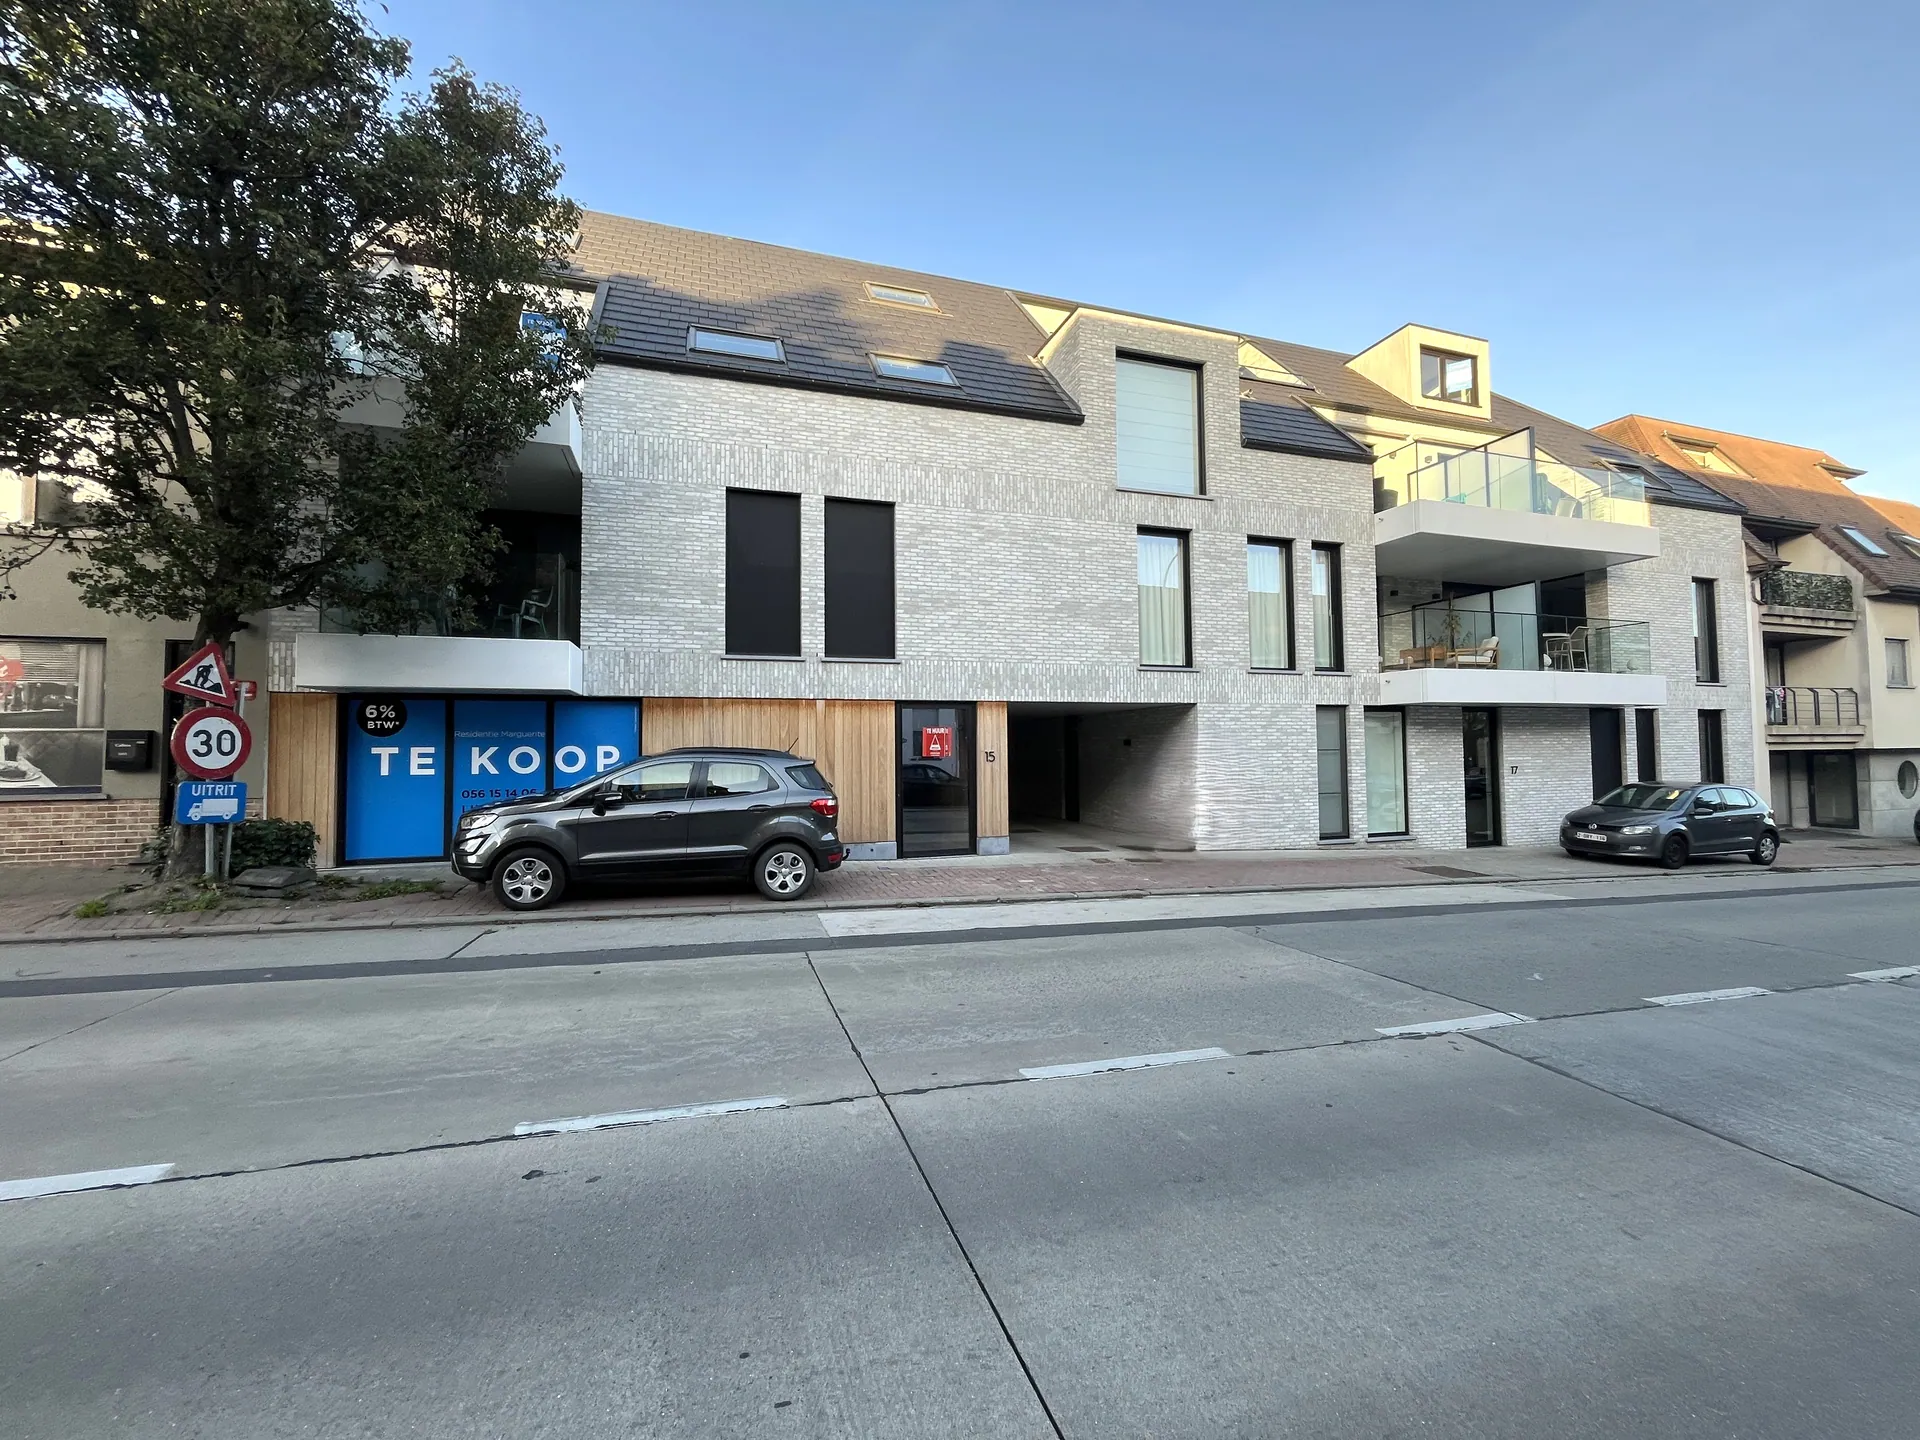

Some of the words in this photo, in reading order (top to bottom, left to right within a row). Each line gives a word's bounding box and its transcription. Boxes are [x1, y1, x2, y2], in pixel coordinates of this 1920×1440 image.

[366, 704, 396, 718] 6%
[454, 730, 499, 738] Residentie
[501, 730, 545, 739] Marguerite
[192, 729, 236, 757] 30
[371, 747, 435, 776] TE
[471, 745, 620, 775] KOOP
[985, 751, 996, 762] 15
[1510, 766, 1519, 774] 17
[191, 783, 237, 796] UITRIT
[461, 789, 486, 798] 056
[490, 789, 501, 798] 15
[505, 788, 518, 797] 14
